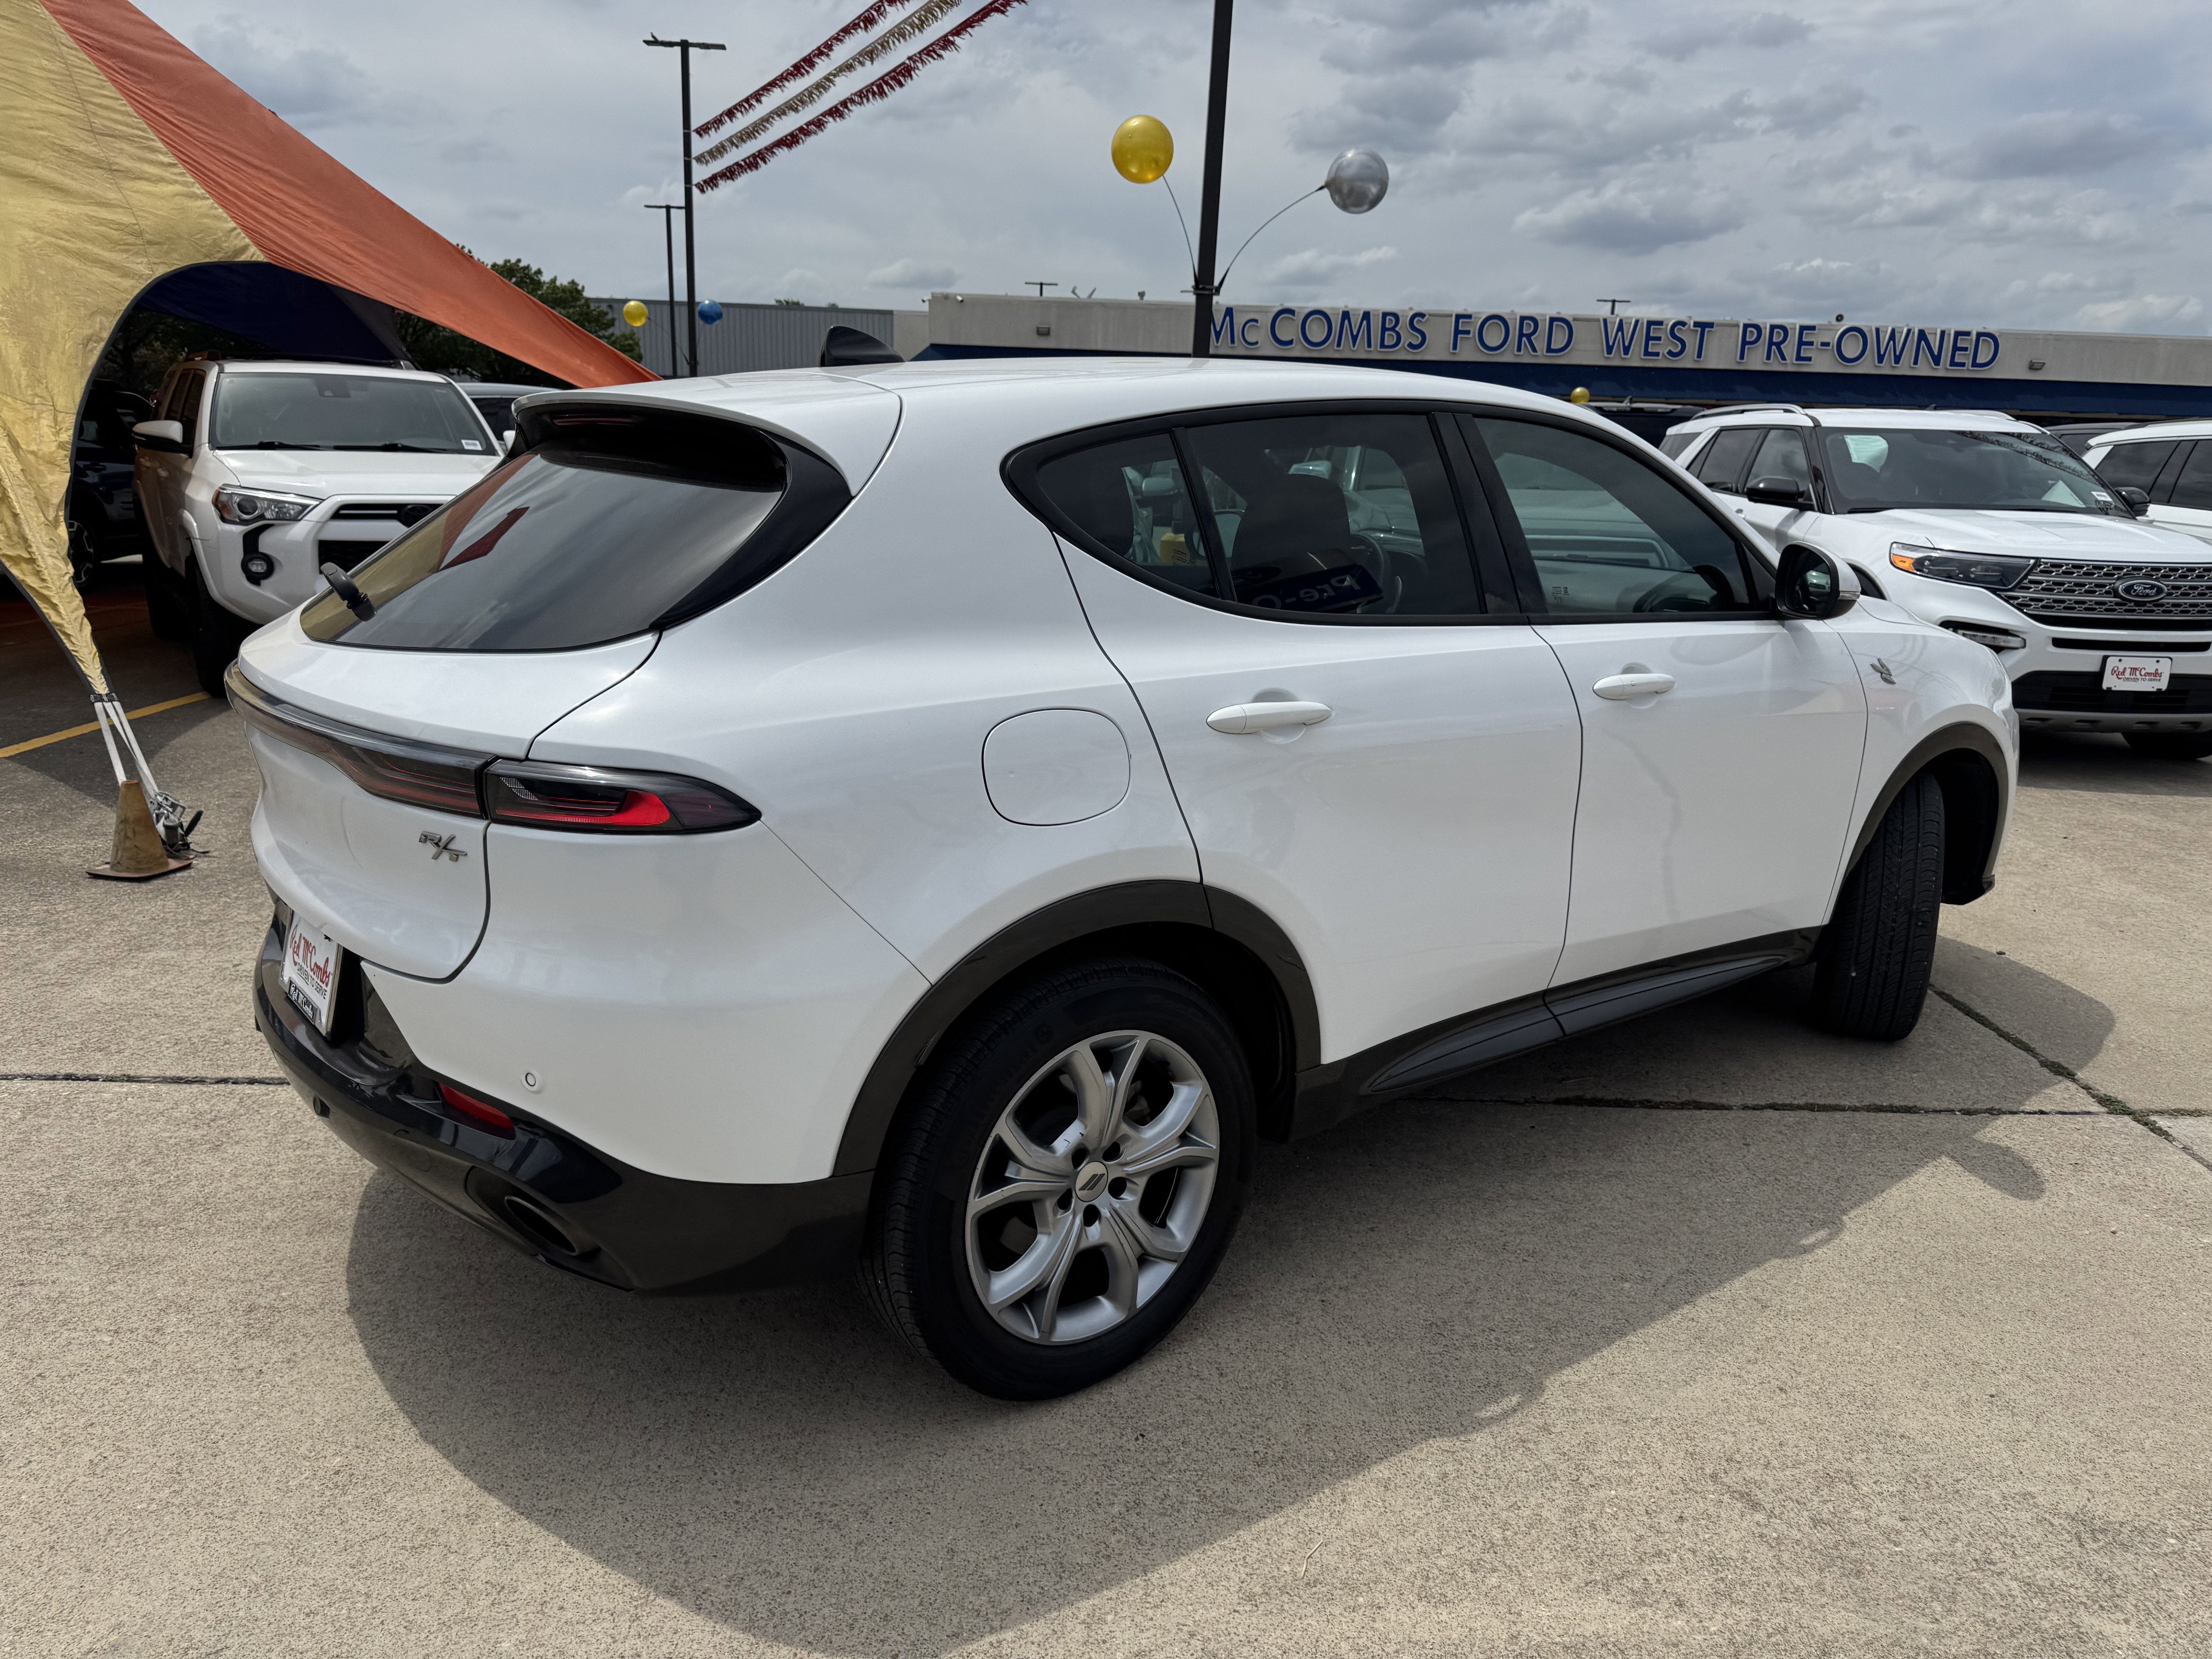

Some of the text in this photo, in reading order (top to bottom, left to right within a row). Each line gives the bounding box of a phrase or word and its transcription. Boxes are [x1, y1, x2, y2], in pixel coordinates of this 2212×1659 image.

[1451, 314, 1574, 354] FORD
[1602, 318, 1714, 359] WEST
[1738, 324, 2000, 369] PRE-OWNED
[2131, 584, 2157, 596] Ford
[2111, 666, 2127, 680] Red
[290, 924, 302, 967] Red
[297, 962, 327, 1000] DRIVEN TO SERVE
